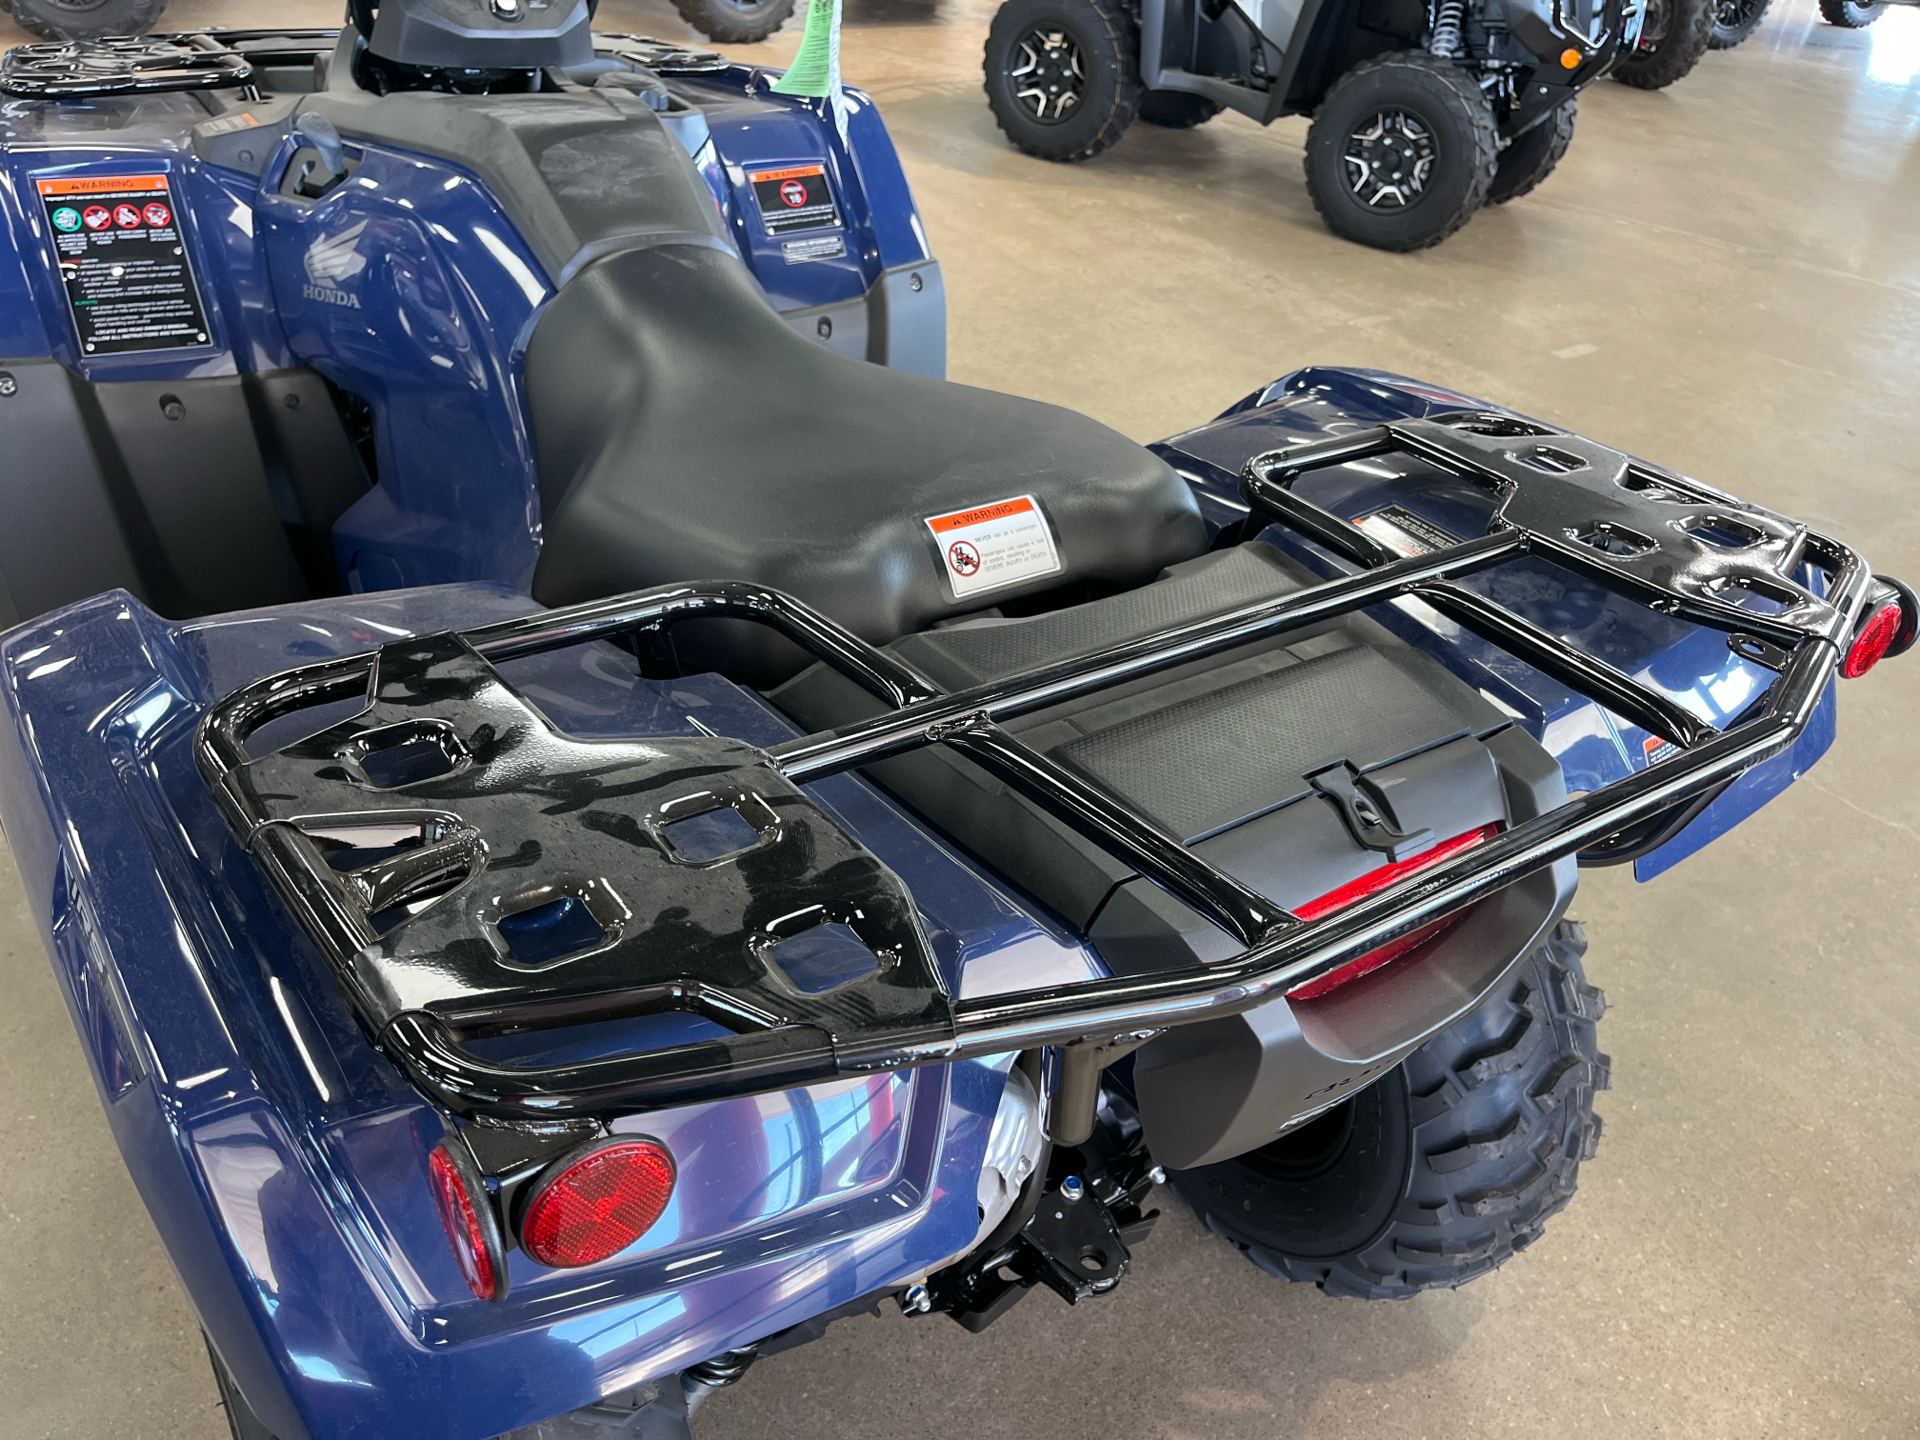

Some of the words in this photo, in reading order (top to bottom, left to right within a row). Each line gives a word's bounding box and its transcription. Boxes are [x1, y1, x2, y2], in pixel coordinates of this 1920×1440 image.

[81, 180, 134, 189] WARNING
[303, 284, 361, 309] HONDA
[963, 505, 1012, 522] WARNING
[974, 534, 992, 543] NEVER
[985, 563, 1004, 572] SEVERE
[1006, 557, 1023, 566] INJURY
